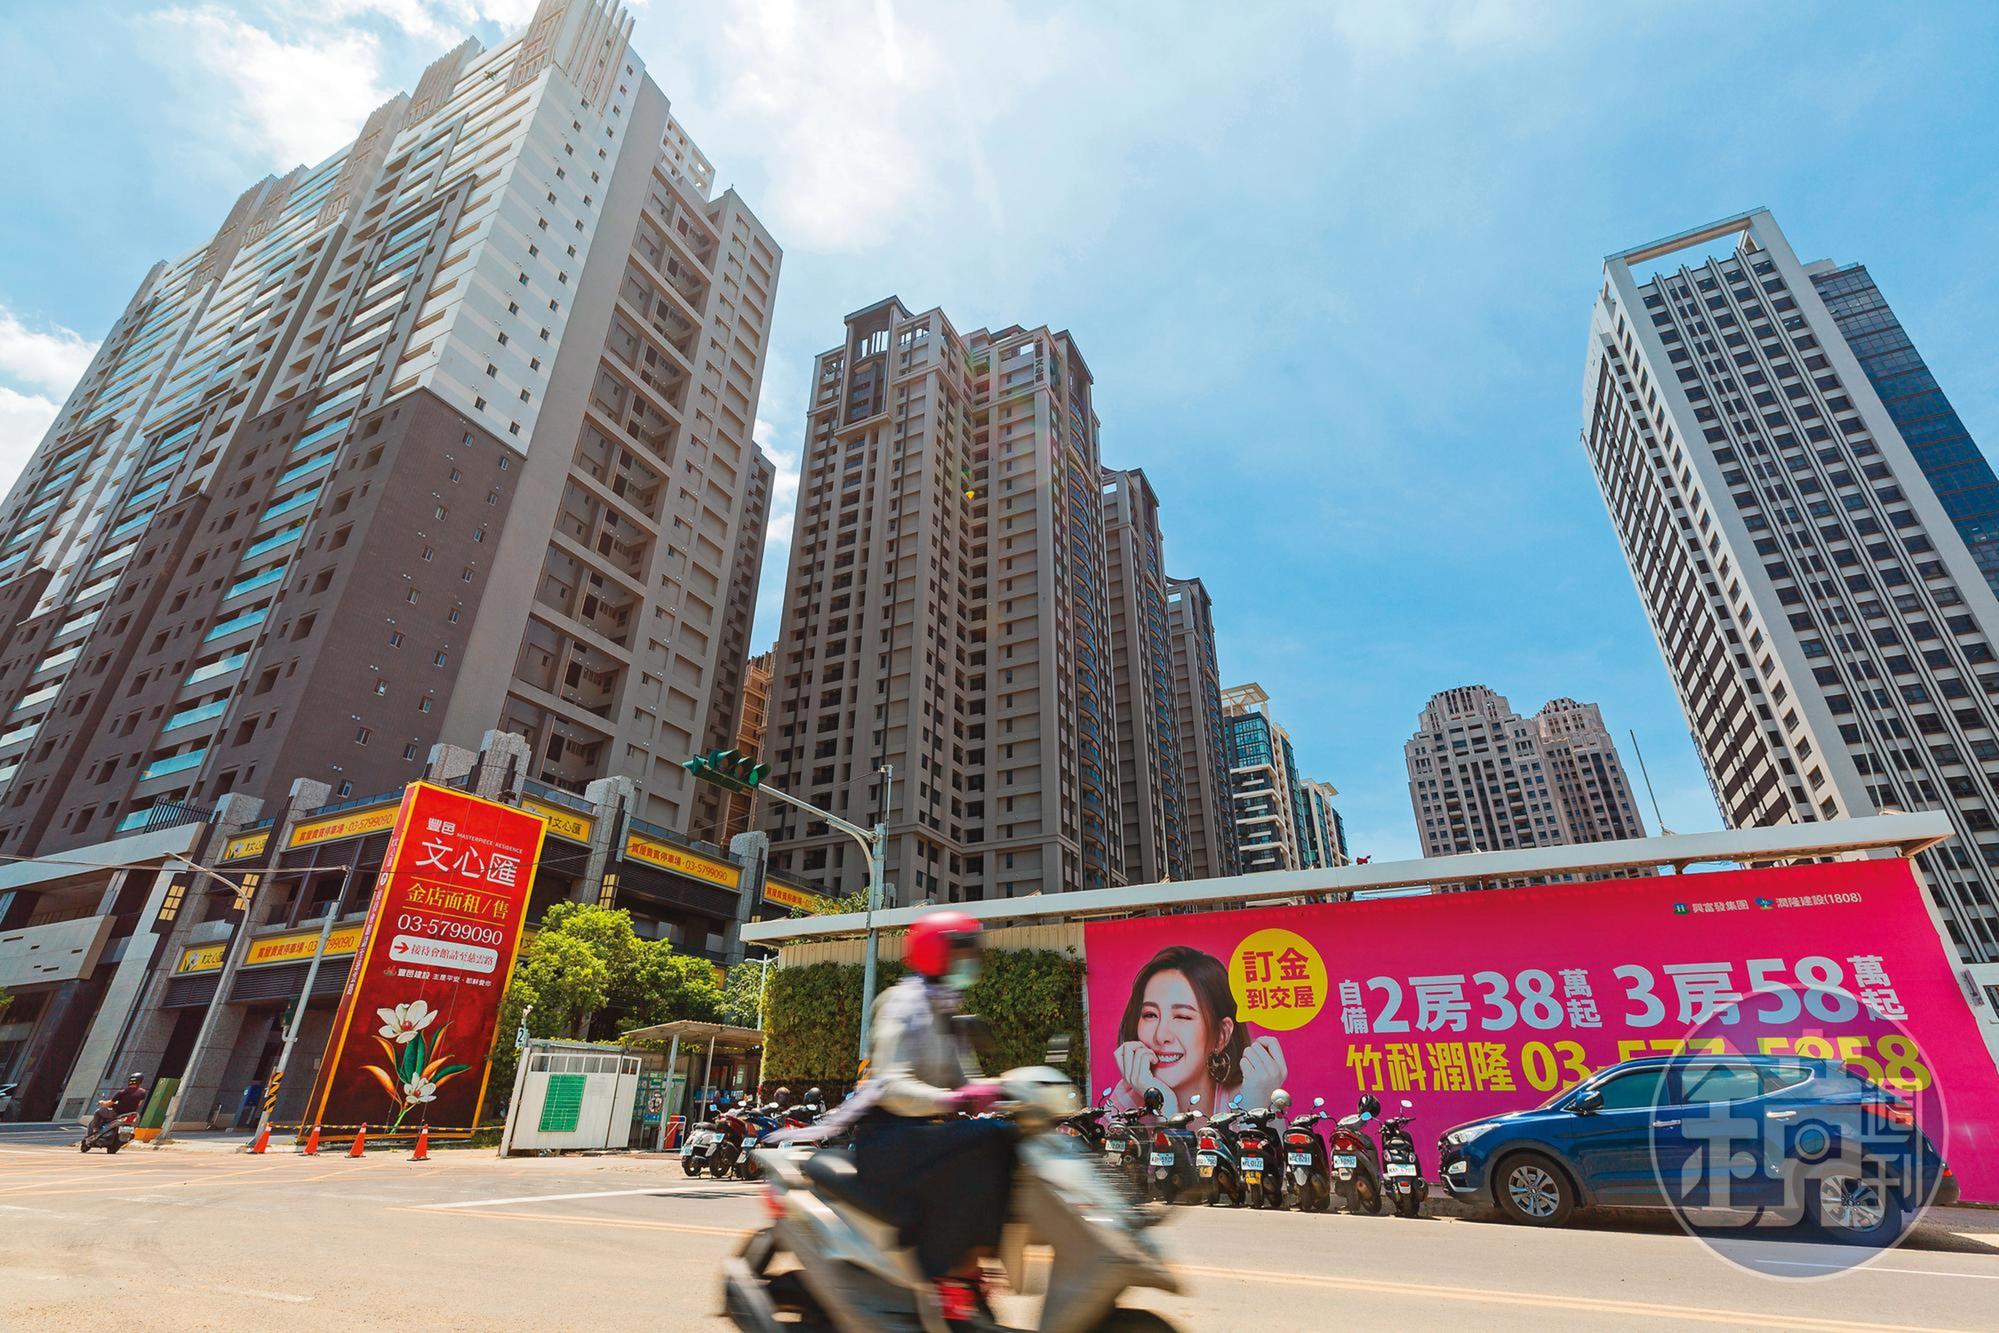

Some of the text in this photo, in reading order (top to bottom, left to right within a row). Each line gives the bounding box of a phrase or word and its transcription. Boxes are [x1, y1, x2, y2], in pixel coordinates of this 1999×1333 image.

[426, 817, 457, 836] 豐邑
[552, 815, 583, 835] 文心匯
[457, 832, 524, 854] MASTERPIECE RESIDENCE
[416, 837, 521, 888] 文心匯
[406, 882, 510, 920] 金店面租/售
[1692, 899, 1750, 914] 興富發集團
[1775, 892, 1863, 909] 潤隆建設(1808)
[397, 913, 503, 945] 03-5799090
[397, 968, 430, 979] 豐邑建設
[1241, 946, 1311, 984] 訂金
[1245, 985, 1316, 1010] 到交屋
[1346, 1041, 1516, 1093] 竹科潤隆
